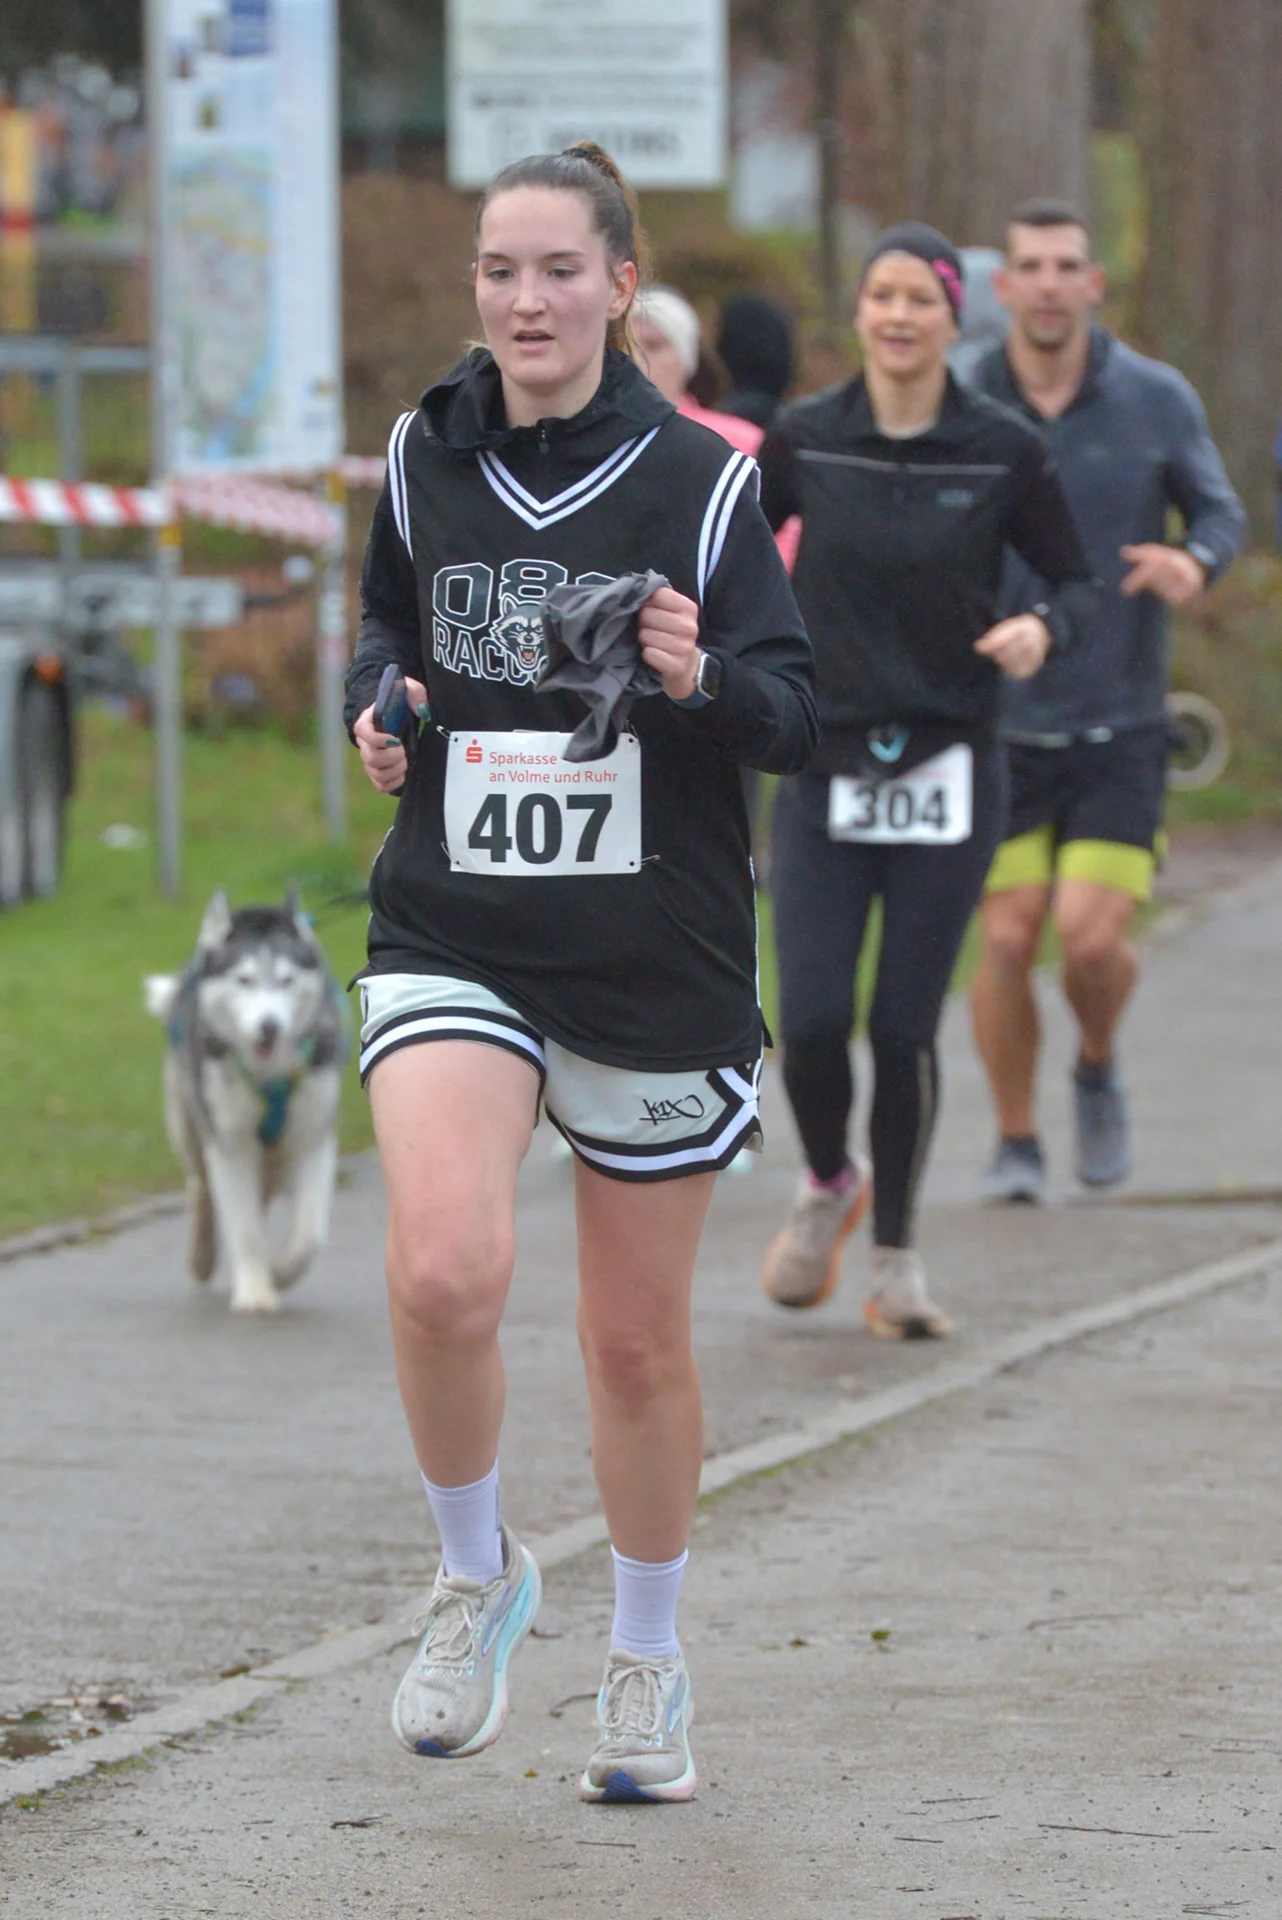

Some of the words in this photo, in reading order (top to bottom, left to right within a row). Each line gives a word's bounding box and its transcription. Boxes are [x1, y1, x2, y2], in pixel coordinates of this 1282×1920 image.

[432, 558, 619, 631] 08
[489, 751, 558, 766] Sparkasse
[489, 771, 505, 783] an
[508, 769, 550, 783] Volme
[554, 770, 581, 783] und
[584, 770, 618, 783] Ruhr
[467, 792, 613, 865] 407
[853, 784, 950, 832] 304
